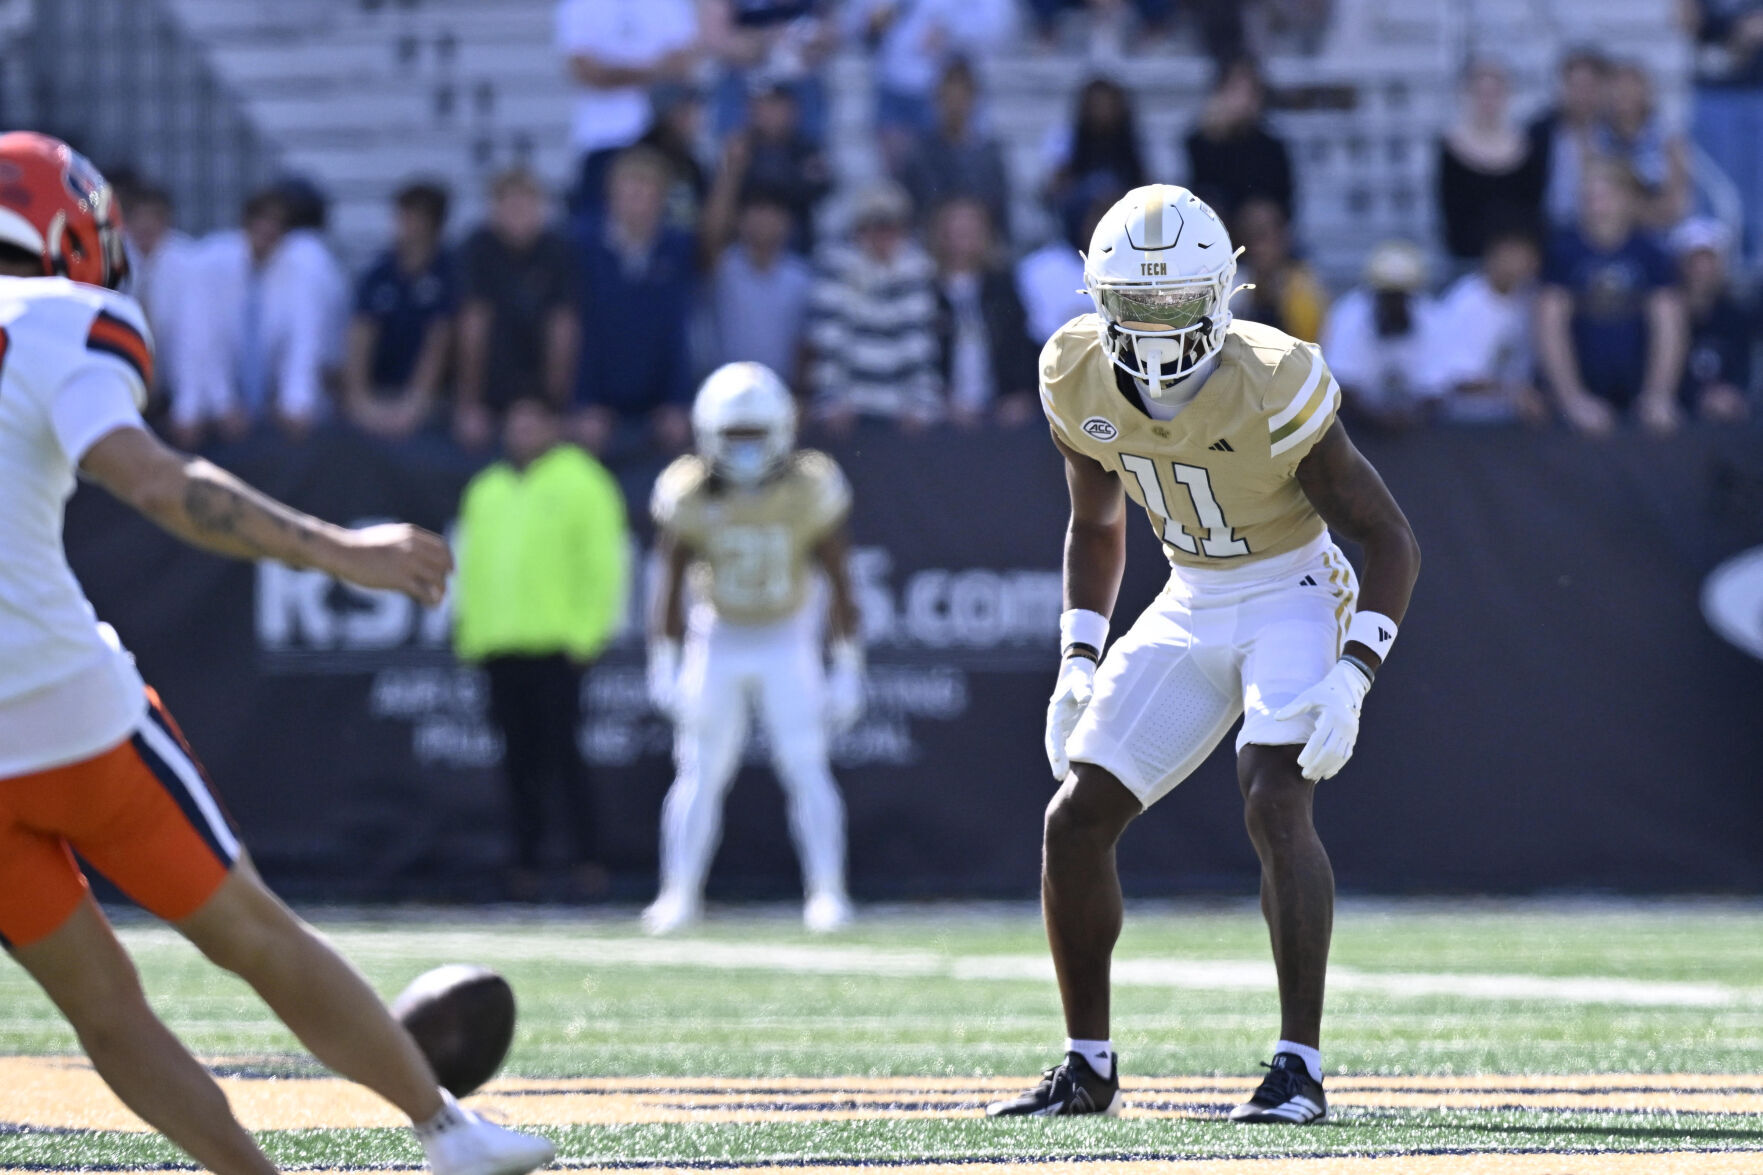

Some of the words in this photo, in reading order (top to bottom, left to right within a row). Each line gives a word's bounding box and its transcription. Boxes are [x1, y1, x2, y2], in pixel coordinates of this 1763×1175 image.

[1140, 262, 1167, 276] TECH
[1088, 422, 1113, 435] ACC
[1119, 451, 1252, 559] 11
